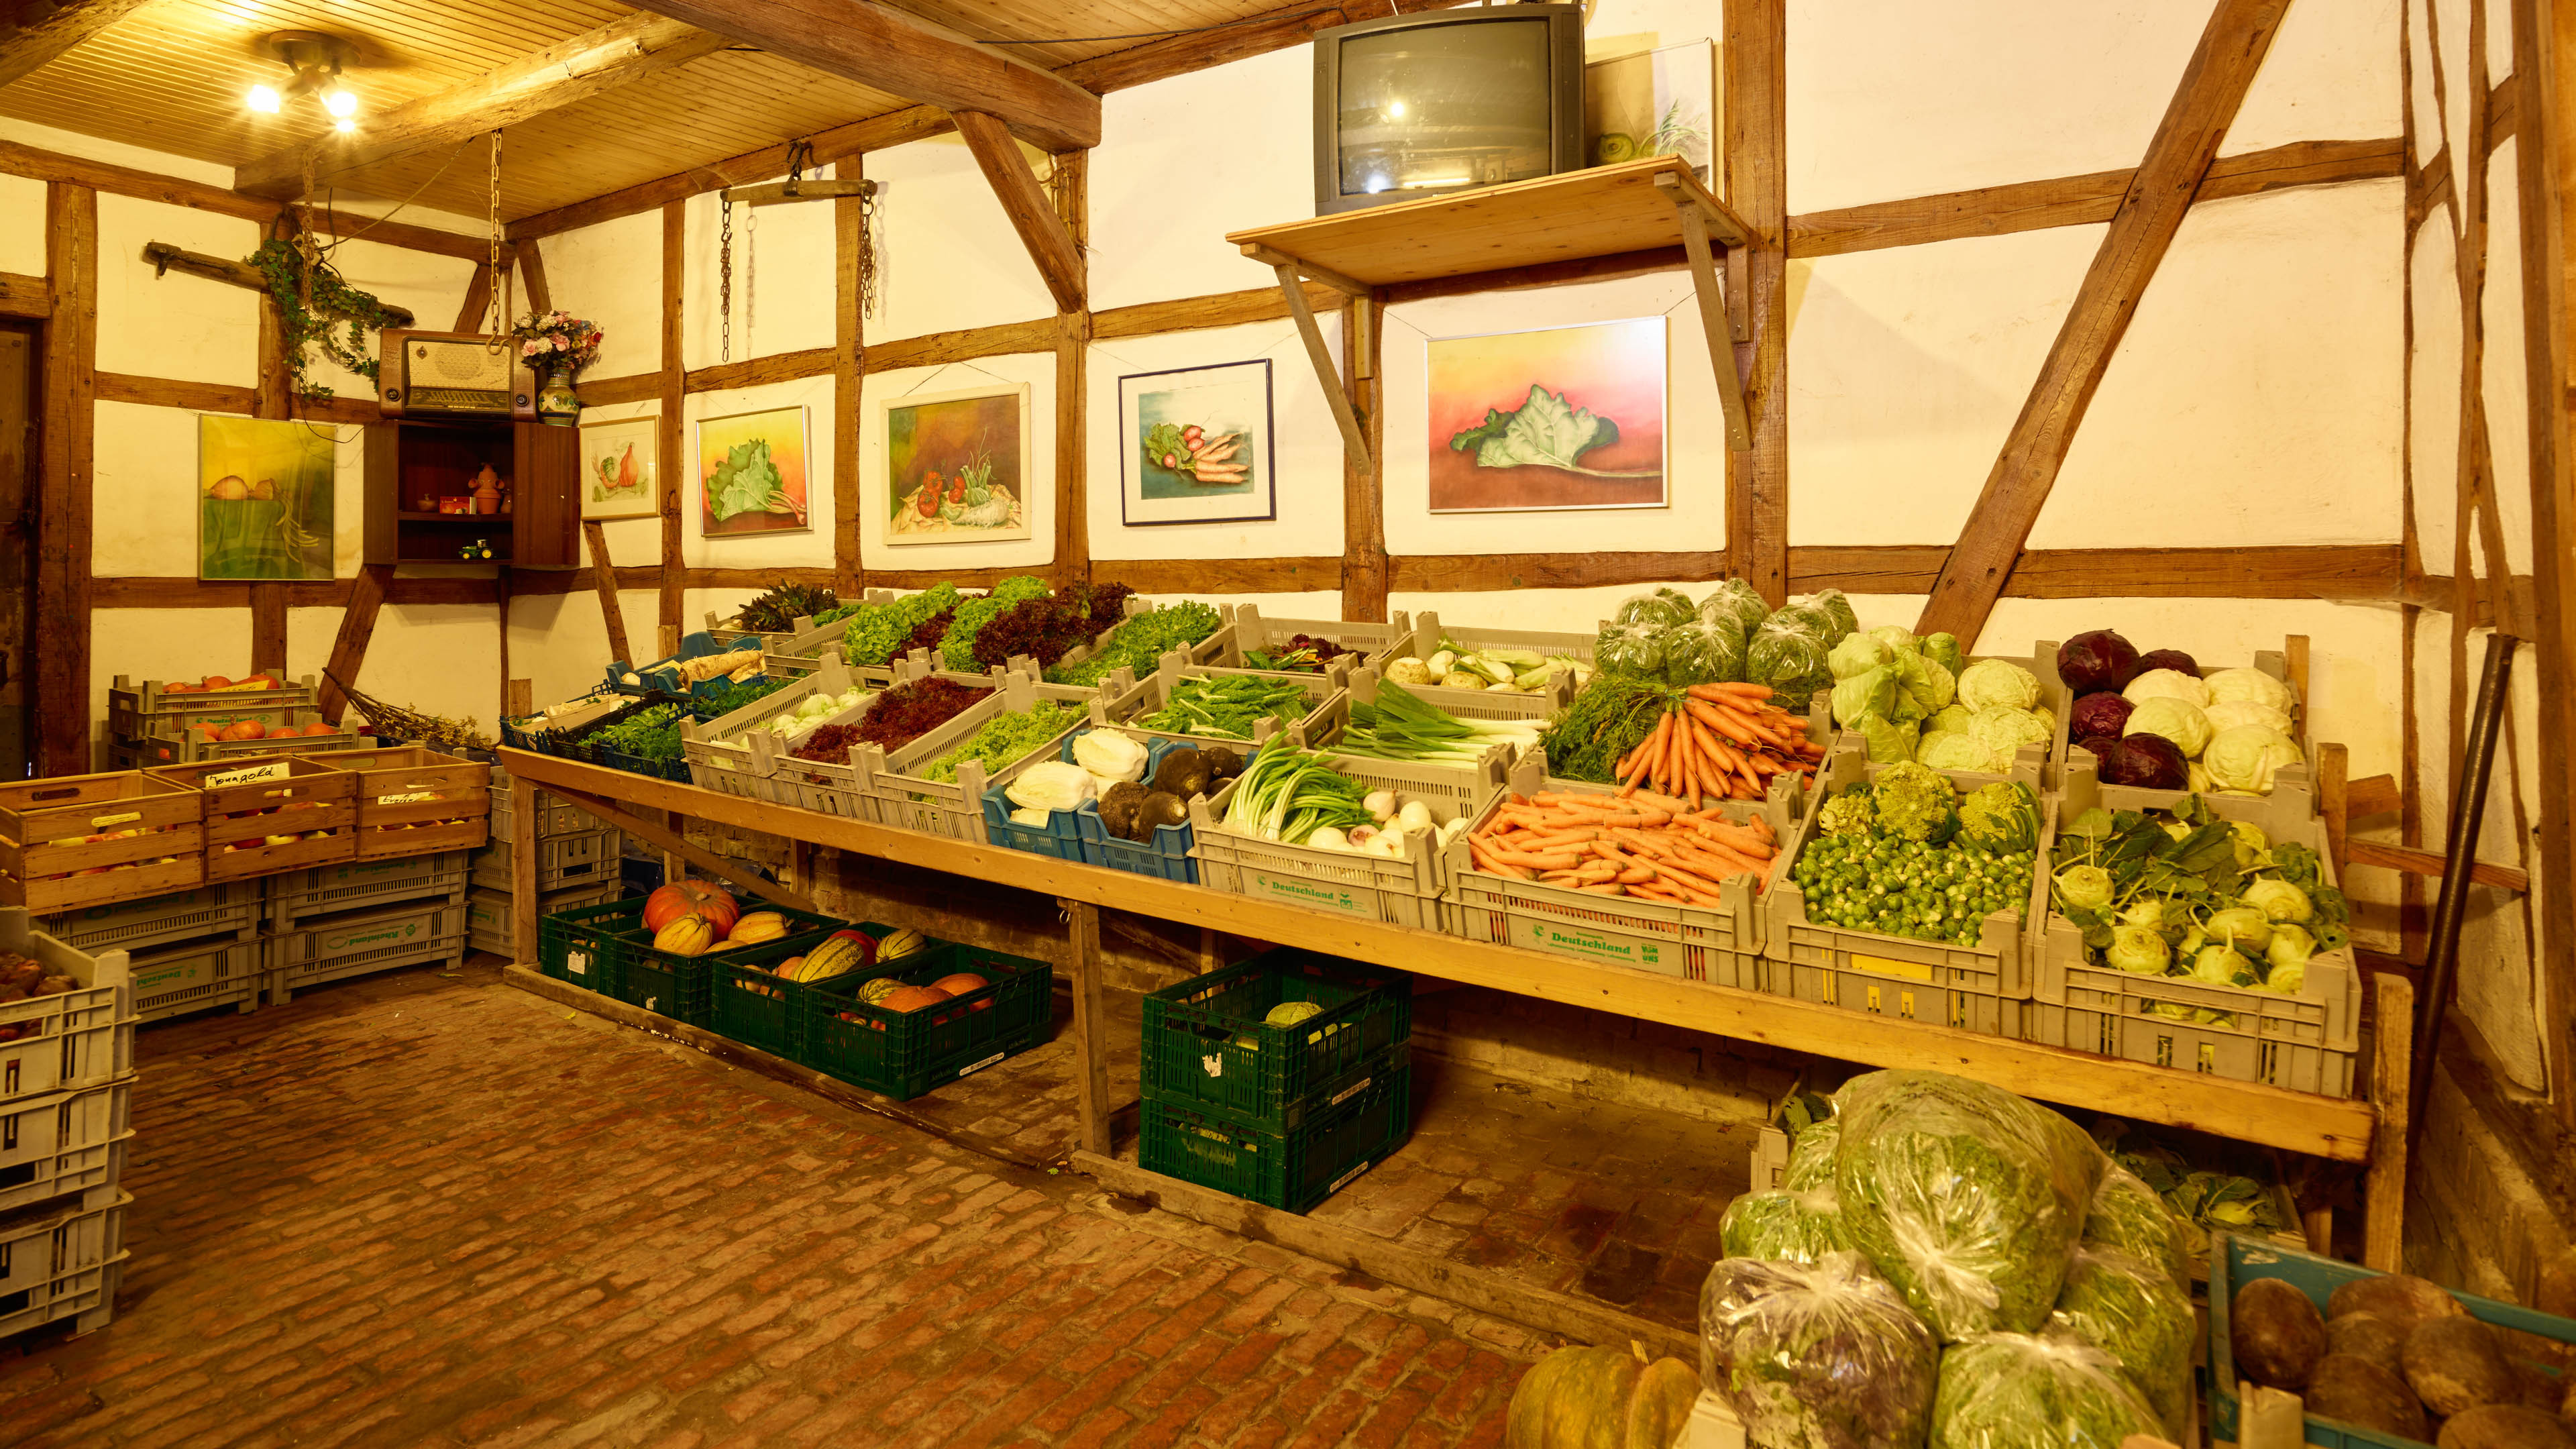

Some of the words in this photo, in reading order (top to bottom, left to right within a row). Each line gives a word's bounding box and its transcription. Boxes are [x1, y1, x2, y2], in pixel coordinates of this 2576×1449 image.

[209, 767, 274, 786] Jonagold
[1272, 881, 1334, 900] Deutschland
[349, 930, 399, 946] Rheinland
[1552, 932, 1631, 955] Deutschland
